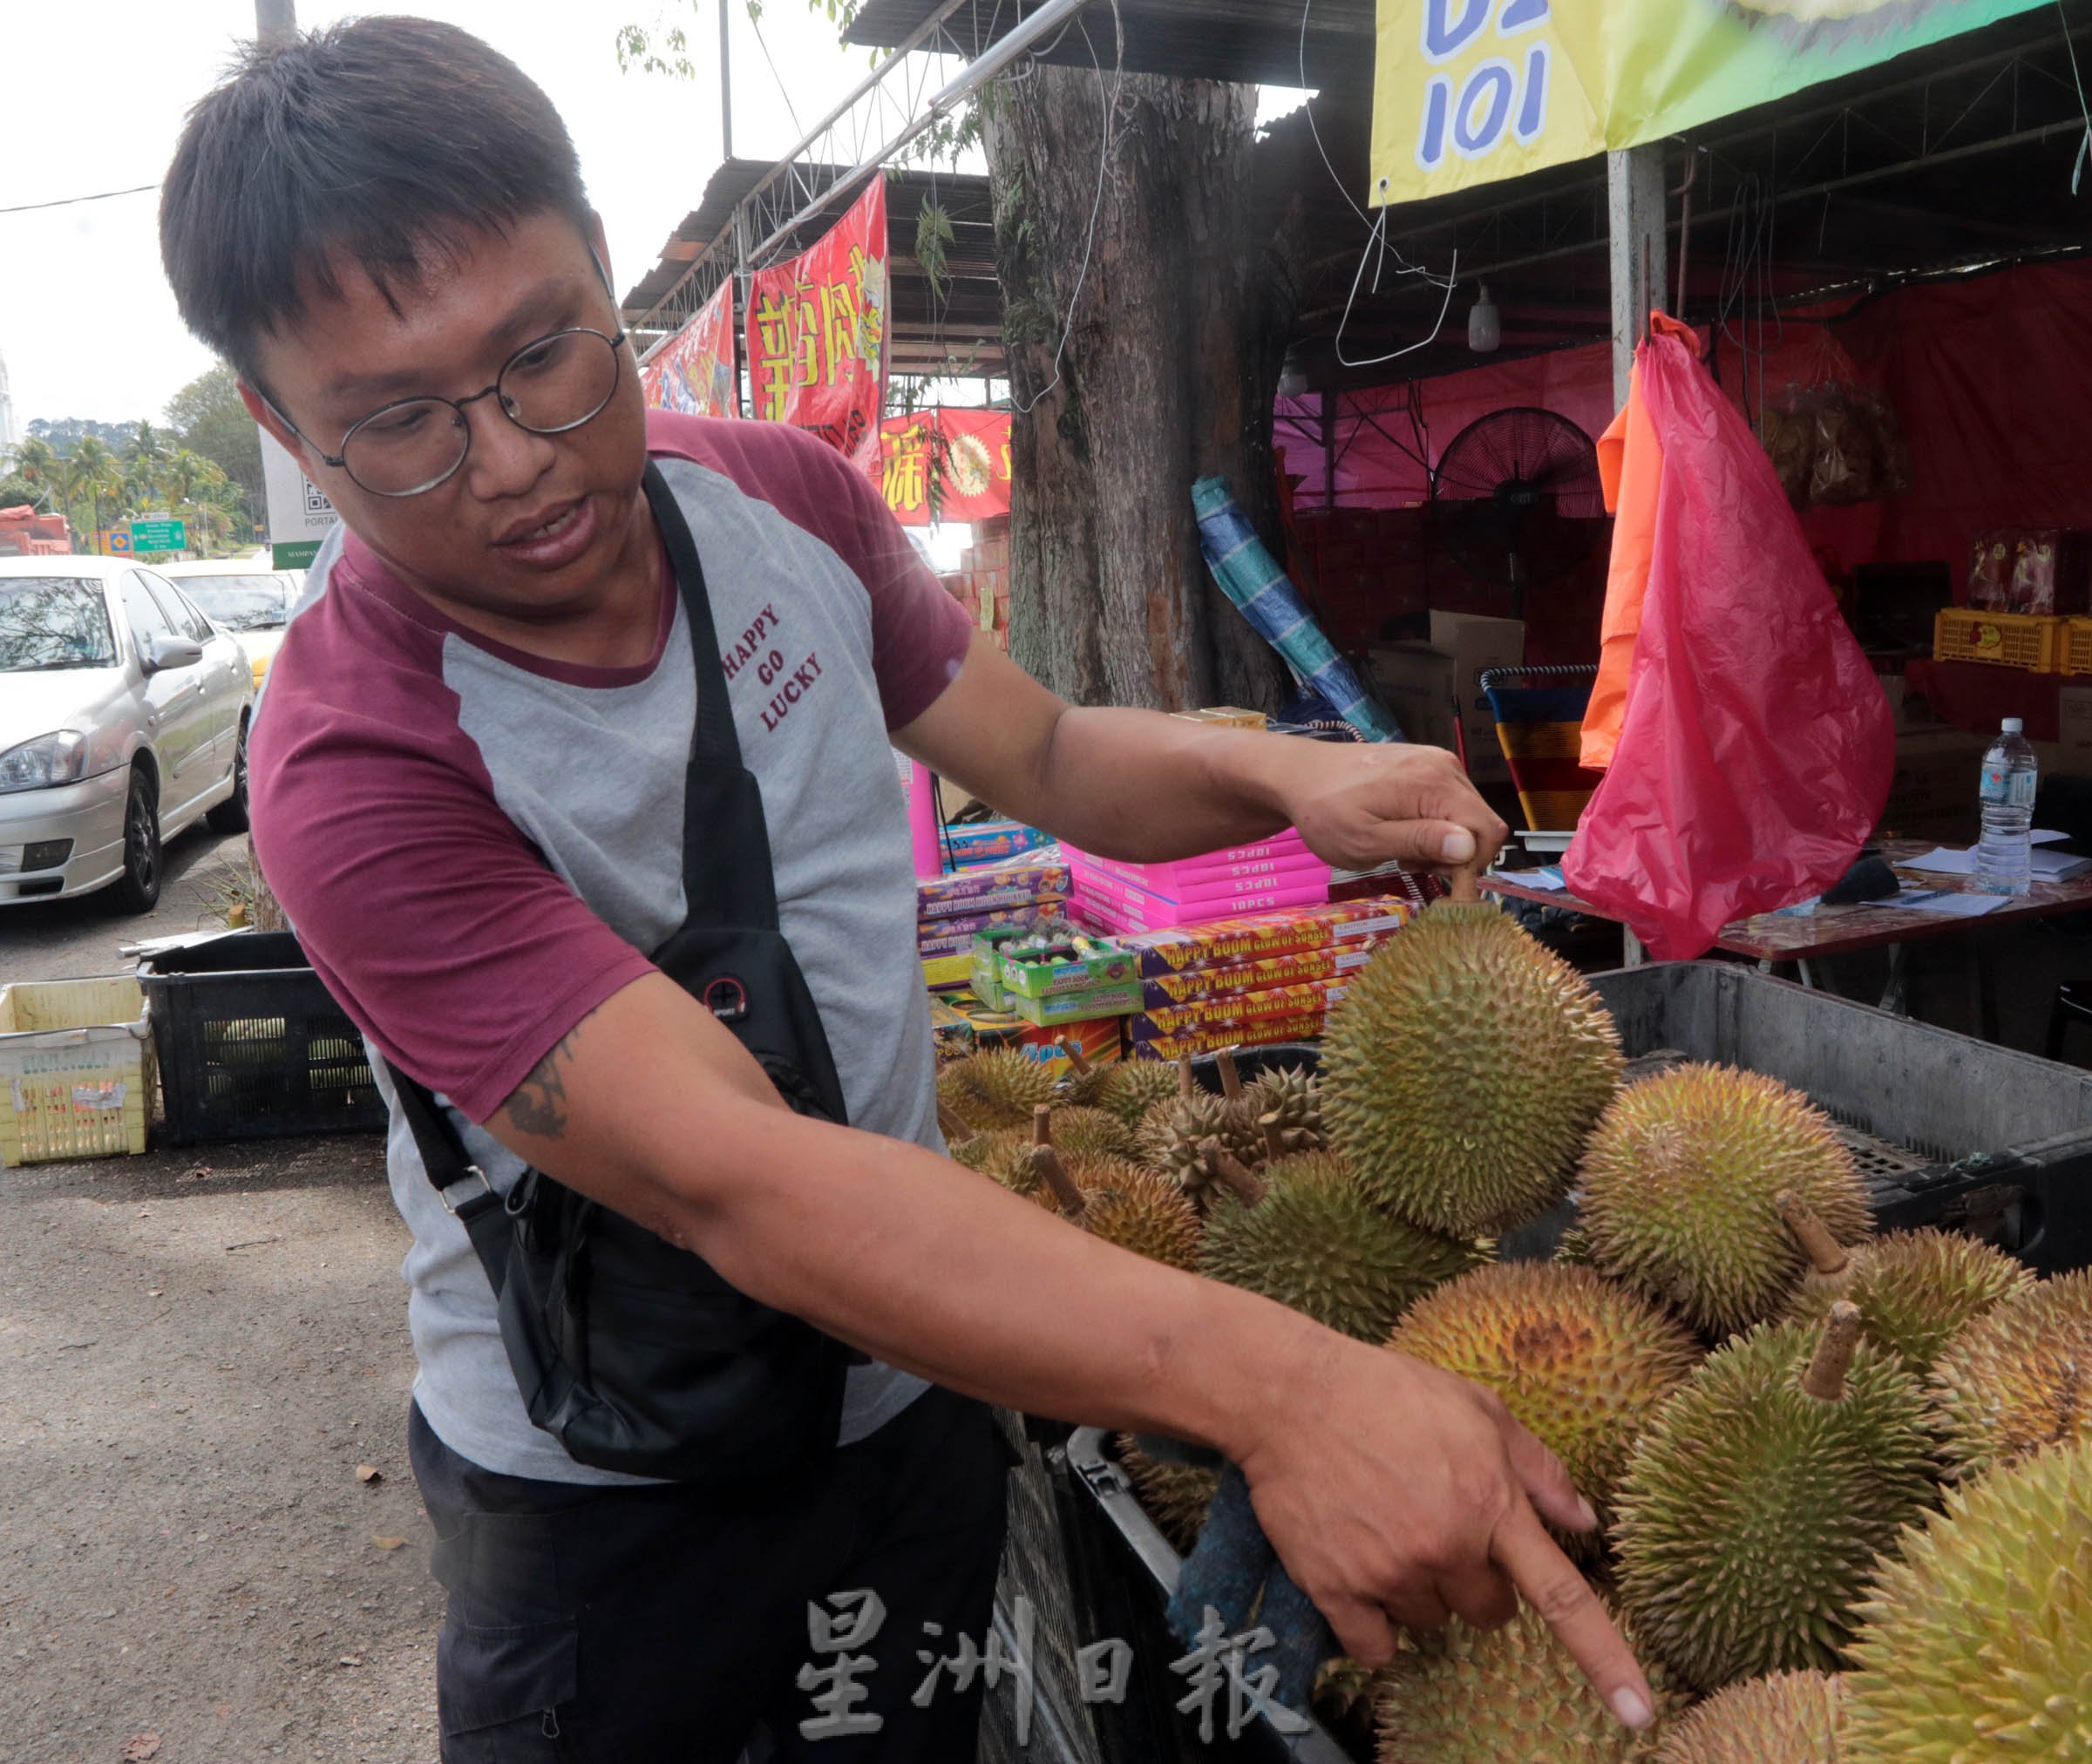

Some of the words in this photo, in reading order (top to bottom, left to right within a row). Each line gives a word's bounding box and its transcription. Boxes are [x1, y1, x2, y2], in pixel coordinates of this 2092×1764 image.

[722, 602, 780, 681] HAPPY
[757, 649, 784, 686] GO
[759, 651, 823, 733] LUCKY
[1165, 944, 1210, 965] HAPPY
[1213, 937, 1252, 957] BOOM
[1253, 936, 1280, 951] GLOW
[1282, 934, 1292, 945] OF
[1295, 929, 1329, 944] SUNSET
[1167, 977, 1212, 998] HAPPY
[1215, 969, 1253, 989] BOOM
[1256, 968, 1282, 983] GLOW
[1284, 967, 1294, 977] OF
[1297, 961, 1331, 974] SUNSET
[1156, 1008, 1201, 1030] HAPPY
[1204, 1001, 1243, 1022] BOOM
[1246, 1000, 1274, 1015] GLOW
[1274, 998, 1284, 1009] OF
[1289, 993, 1323, 1008] SUNSET
